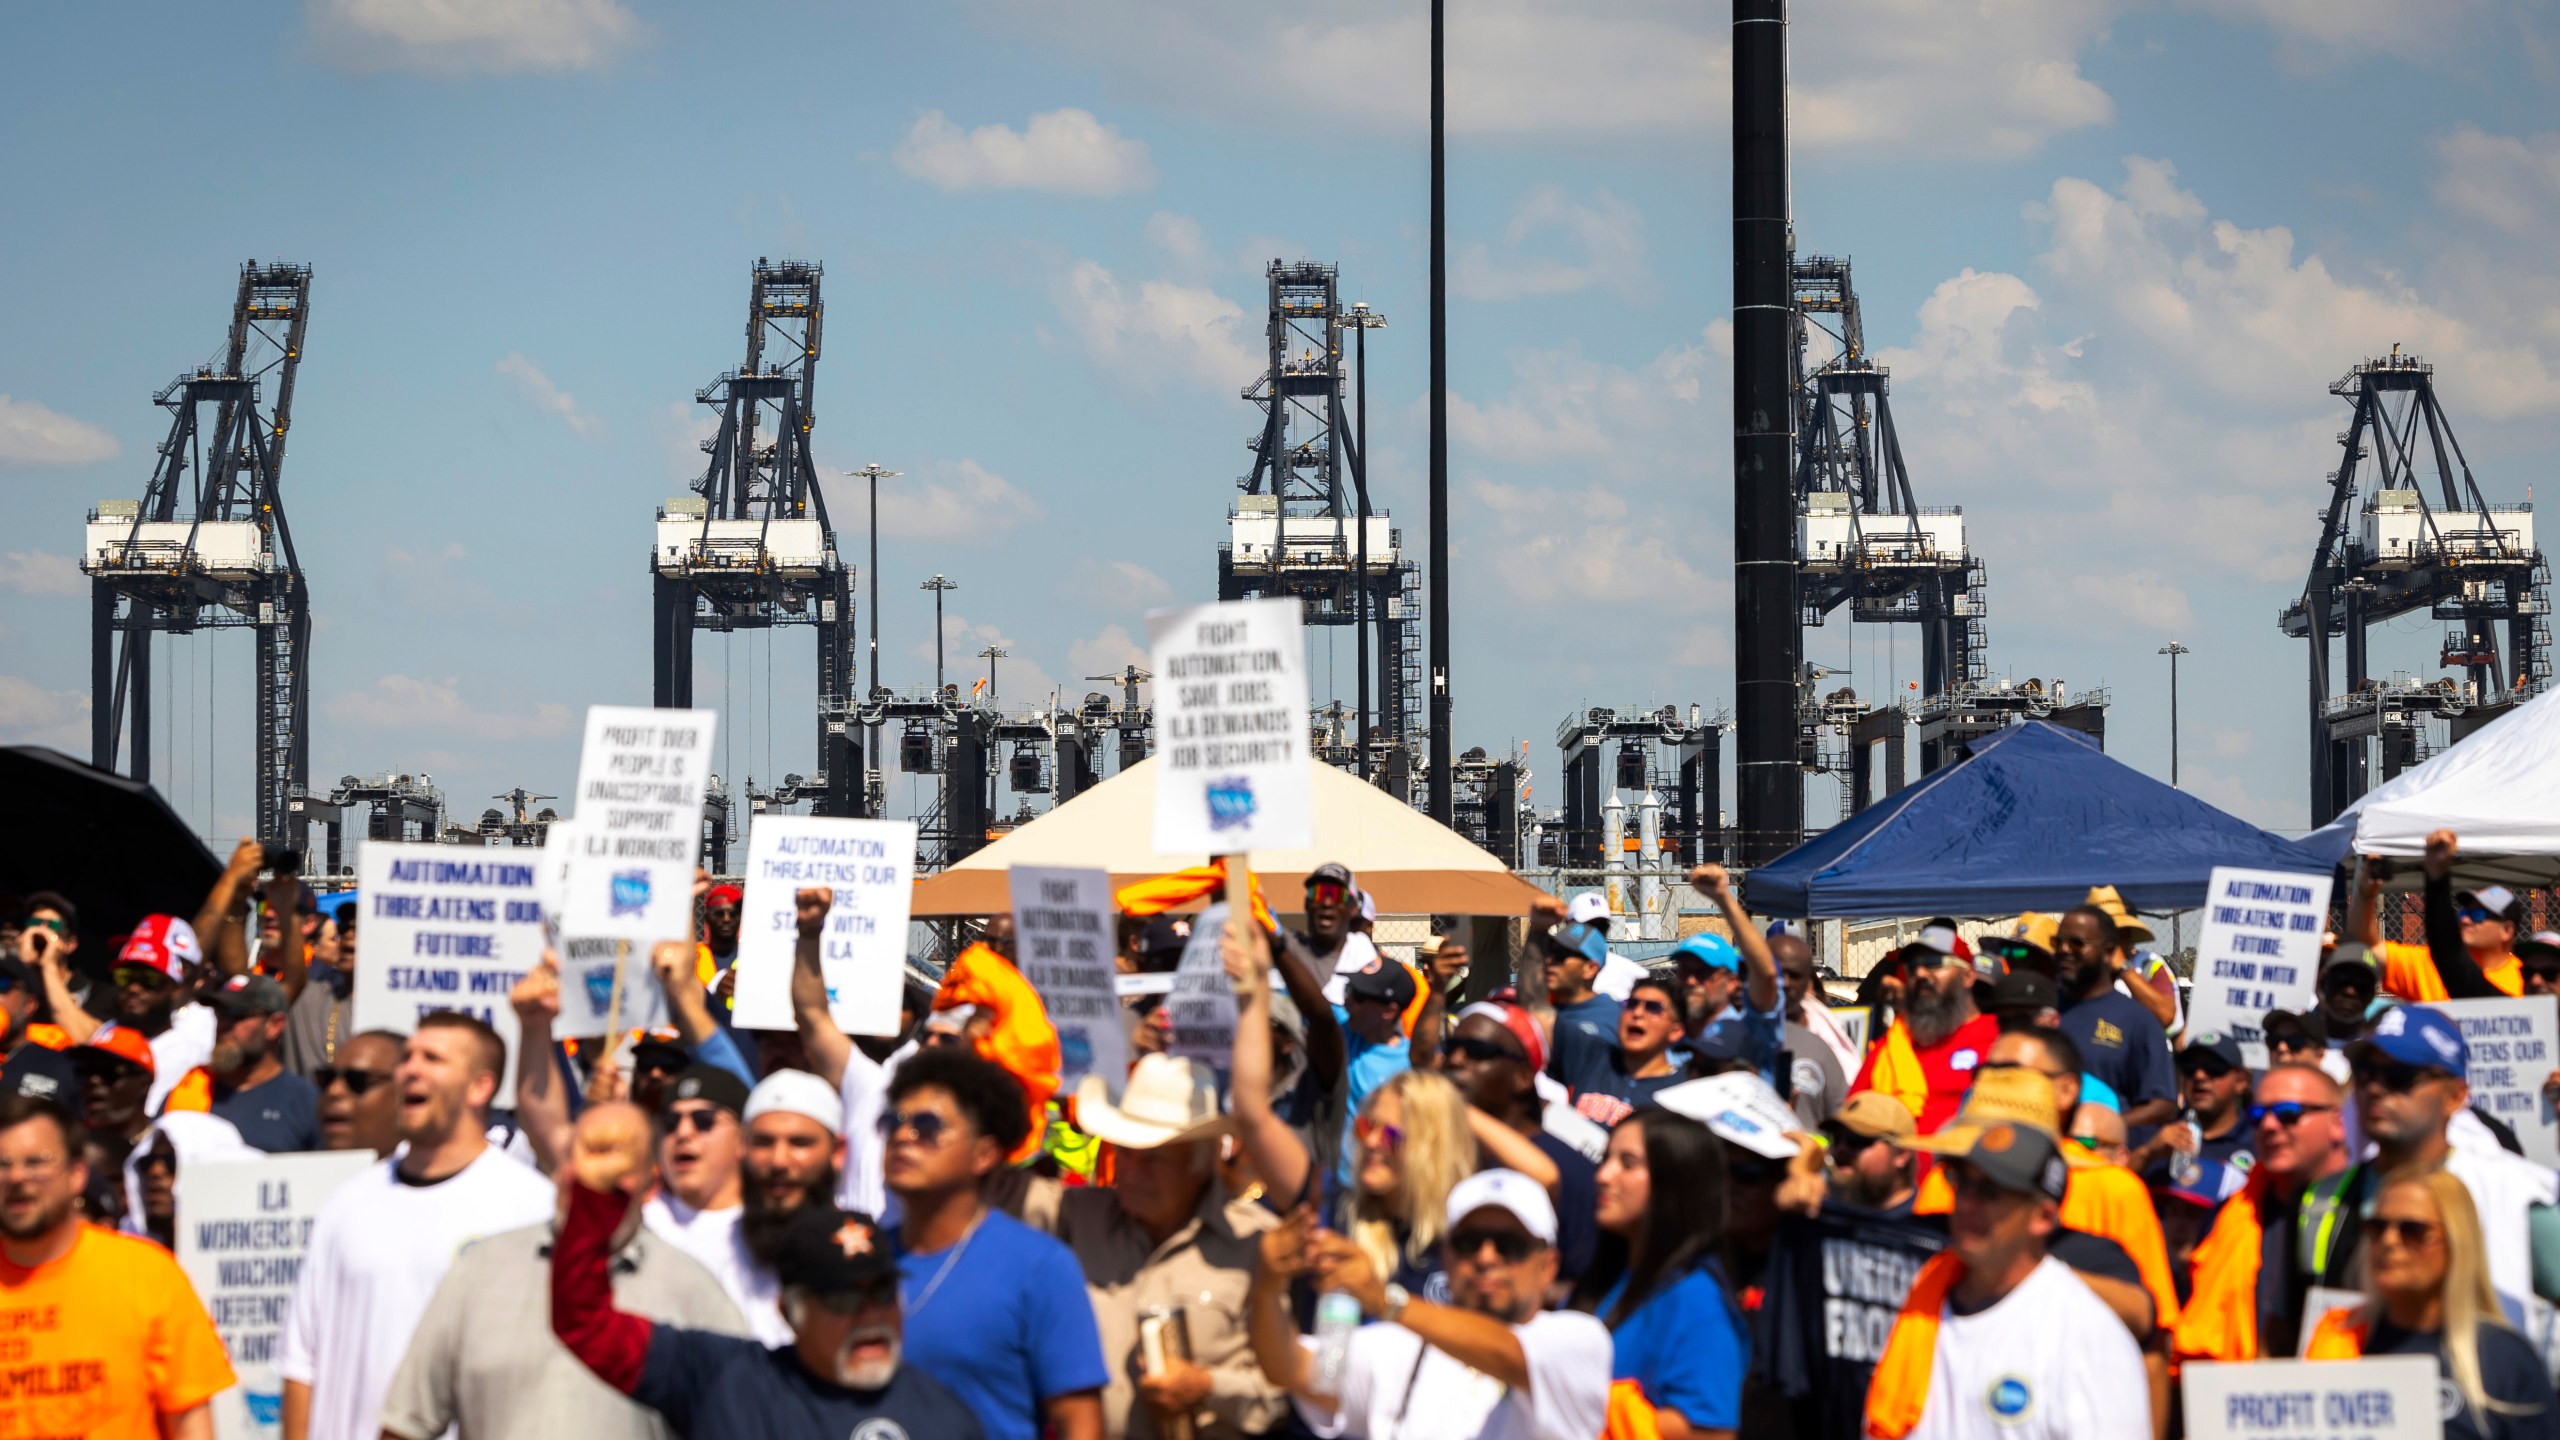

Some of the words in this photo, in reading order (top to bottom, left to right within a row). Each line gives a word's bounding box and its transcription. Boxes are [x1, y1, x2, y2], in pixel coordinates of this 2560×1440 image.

[778, 836, 885, 858] AUTOMATION
[389, 859, 535, 887] AUTOMATION
[763, 860, 856, 882] THREATENS
[862, 866, 896, 885] OUR
[2225, 879, 2313, 905] AUTOMATION
[373, 893, 497, 922] THREATENS
[2211, 905, 2286, 931] THREATENS
[2289, 913, 2317, 934] OUR
[833, 915, 877, 934] WITH
[826, 941, 853, 960] ILA
[387, 966, 460, 992] STAND
[2212, 959, 2257, 981] STAND
[2260, 964, 2298, 986] WITH
[2226, 986, 2250, 1008] THE
[2252, 990, 2275, 1011] ILA
[2458, 1014, 2534, 1039] TOMATION
[2513, 1039, 2546, 1063] OUR
[2494, 1090, 2535, 1113] WITH
[258, 1179, 290, 1211] ILA
[195, 1217, 292, 1251] WORKERS
[216, 1257, 307, 1289] MACHIN
[2225, 1389, 2315, 1432] PROFIT
[2323, 1387, 2396, 1430] OVER
